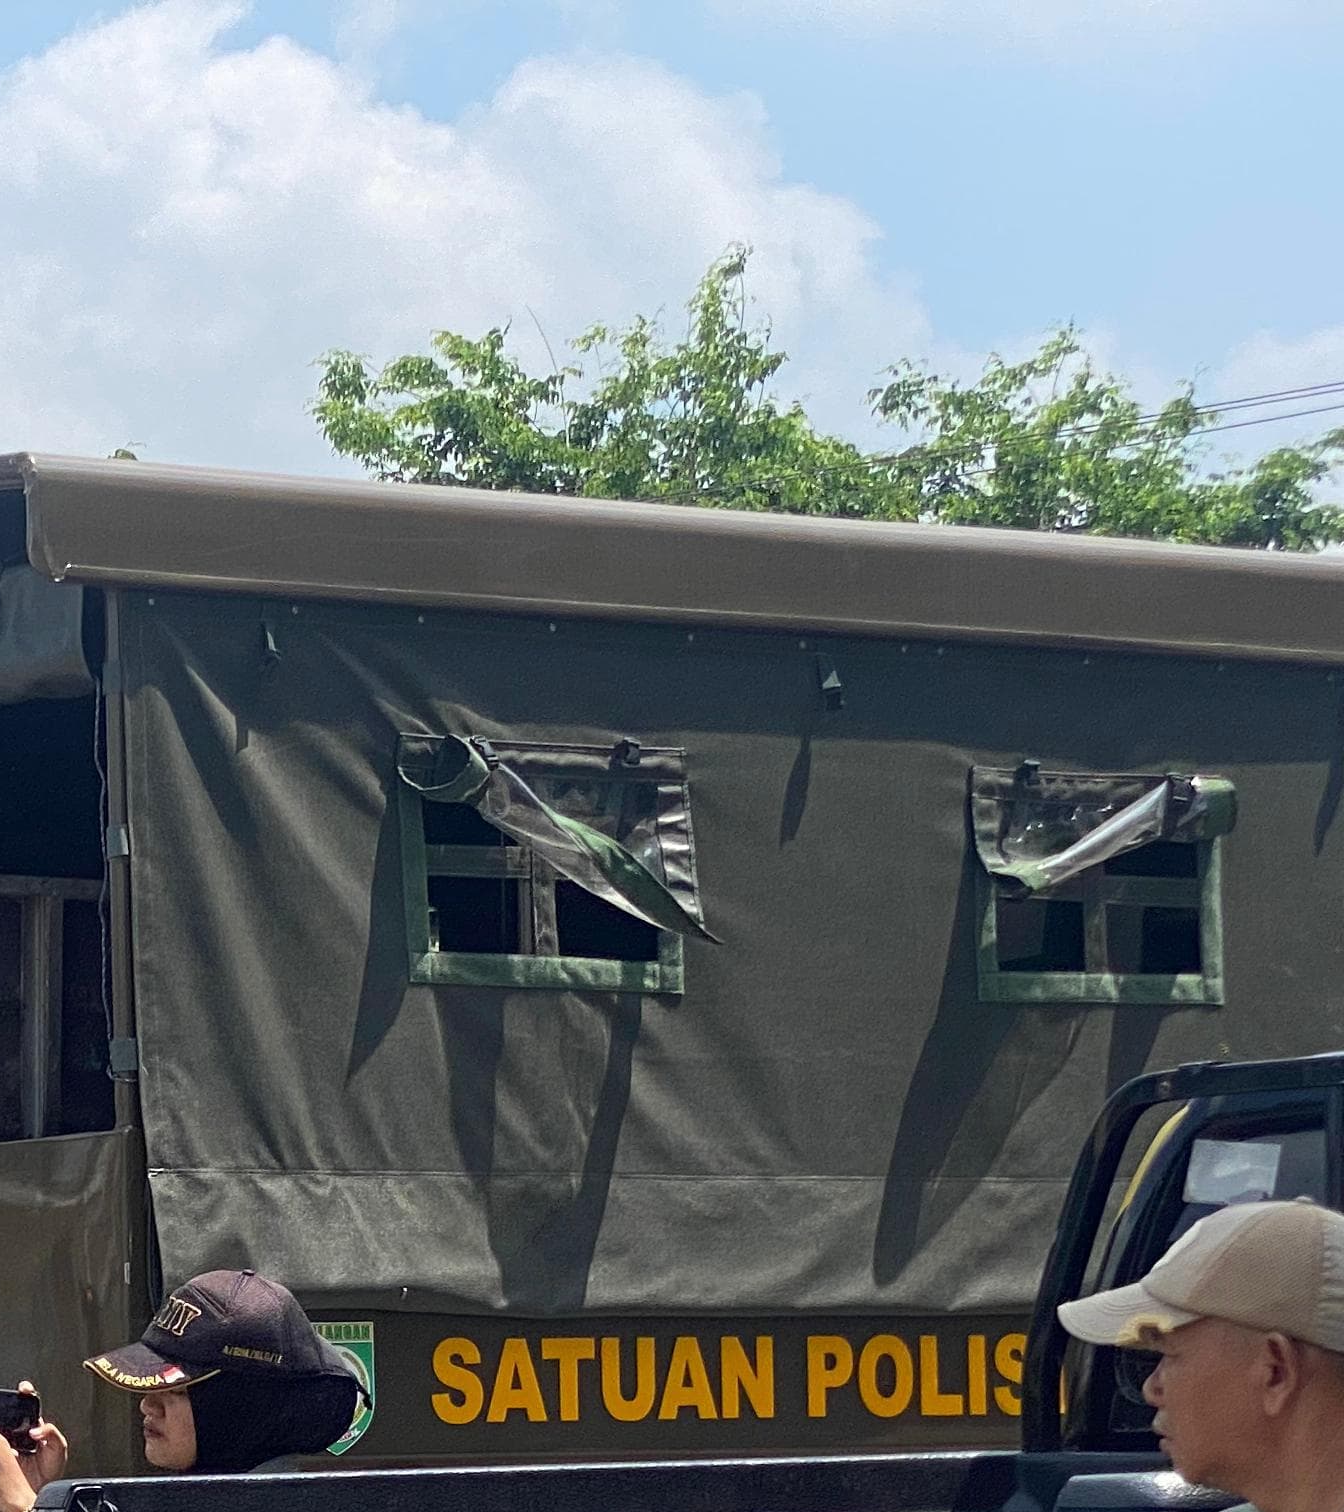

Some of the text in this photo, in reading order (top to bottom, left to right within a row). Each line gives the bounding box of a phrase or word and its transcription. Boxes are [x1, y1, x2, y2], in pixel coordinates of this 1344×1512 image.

[115, 1372, 164, 1387] NEGARA
[431, 1333, 1065, 1424] SATUAN POLIS
